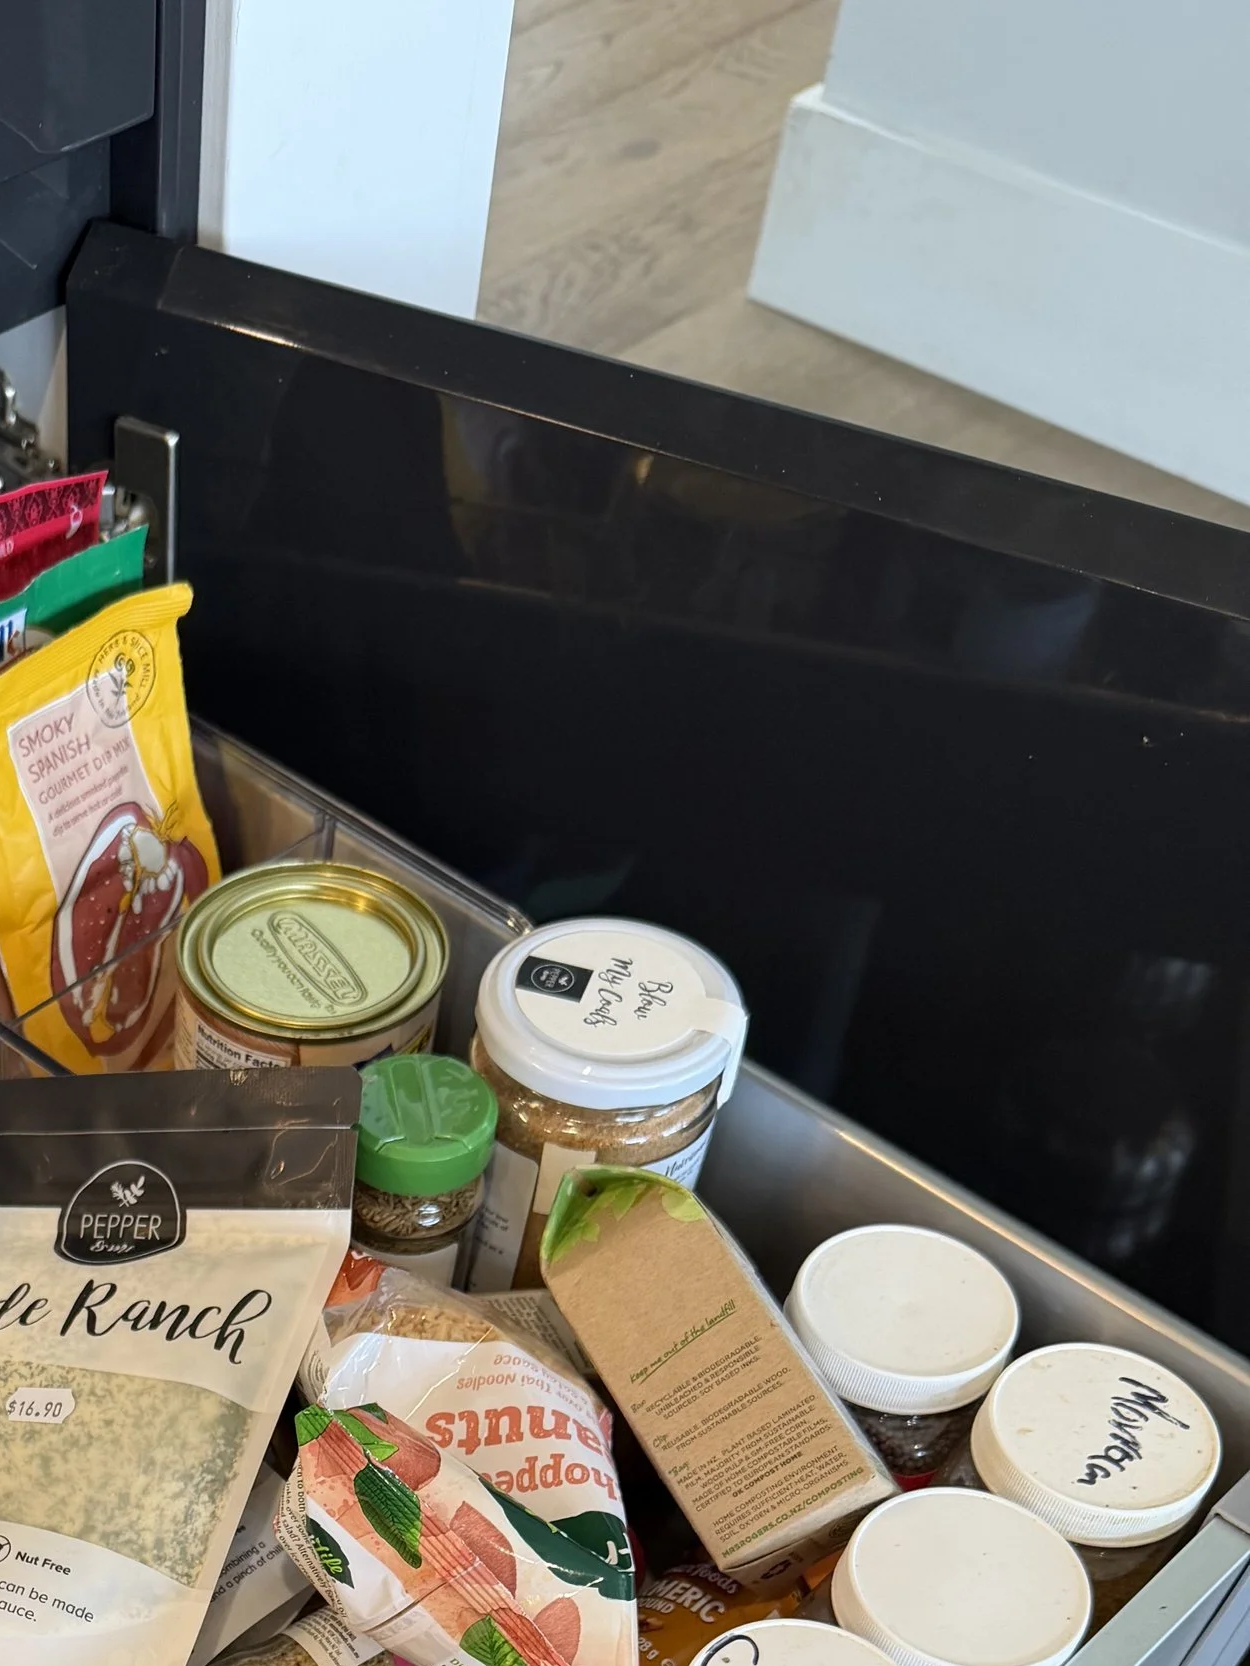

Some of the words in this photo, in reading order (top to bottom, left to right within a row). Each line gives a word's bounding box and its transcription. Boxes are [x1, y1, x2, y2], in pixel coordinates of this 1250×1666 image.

[18, 713, 75, 757] SMOKY
[25, 733, 94, 783] SPANISH
[39, 763, 90, 804] GOURMET
[89, 750, 114, 771] DIP
[109, 736, 135, 757] MIX
[598, 957, 634, 988] My
[583, 987, 623, 1028] Coals
[634, 980, 674, 1021] Blow
[197, 1024, 242, 1061] Nutrition
[79, 1213, 162, 1241] PEPPER
[60, 1278, 273, 1366] Ranch
[630, 1367, 648, 1384] Keep
[648, 1355, 662, 1368] me
[663, 1343, 678, 1359] out
[680, 1332, 691, 1346] of
[688, 1325, 705, 1337] the
[705, 1299, 736, 1326] landfill
[456, 1372, 516, 1392] Noodles
[520, 1373, 551, 1394] Thai
[7, 1399, 63, 1418] $16.90
[730, 1486, 745, 1499] OK
[742, 1463, 781, 1490] COMPOST
[778, 1449, 804, 1469] HOME
[722, 1464, 864, 1558] MRSROGERS.CO.NZ/COMPOSTING
[15, 1550, 40, 1565] Nut
[42, 1556, 71, 1577] Free
[28, 1584, 49, 1605] be
[51, 1596, 95, 1623] made
